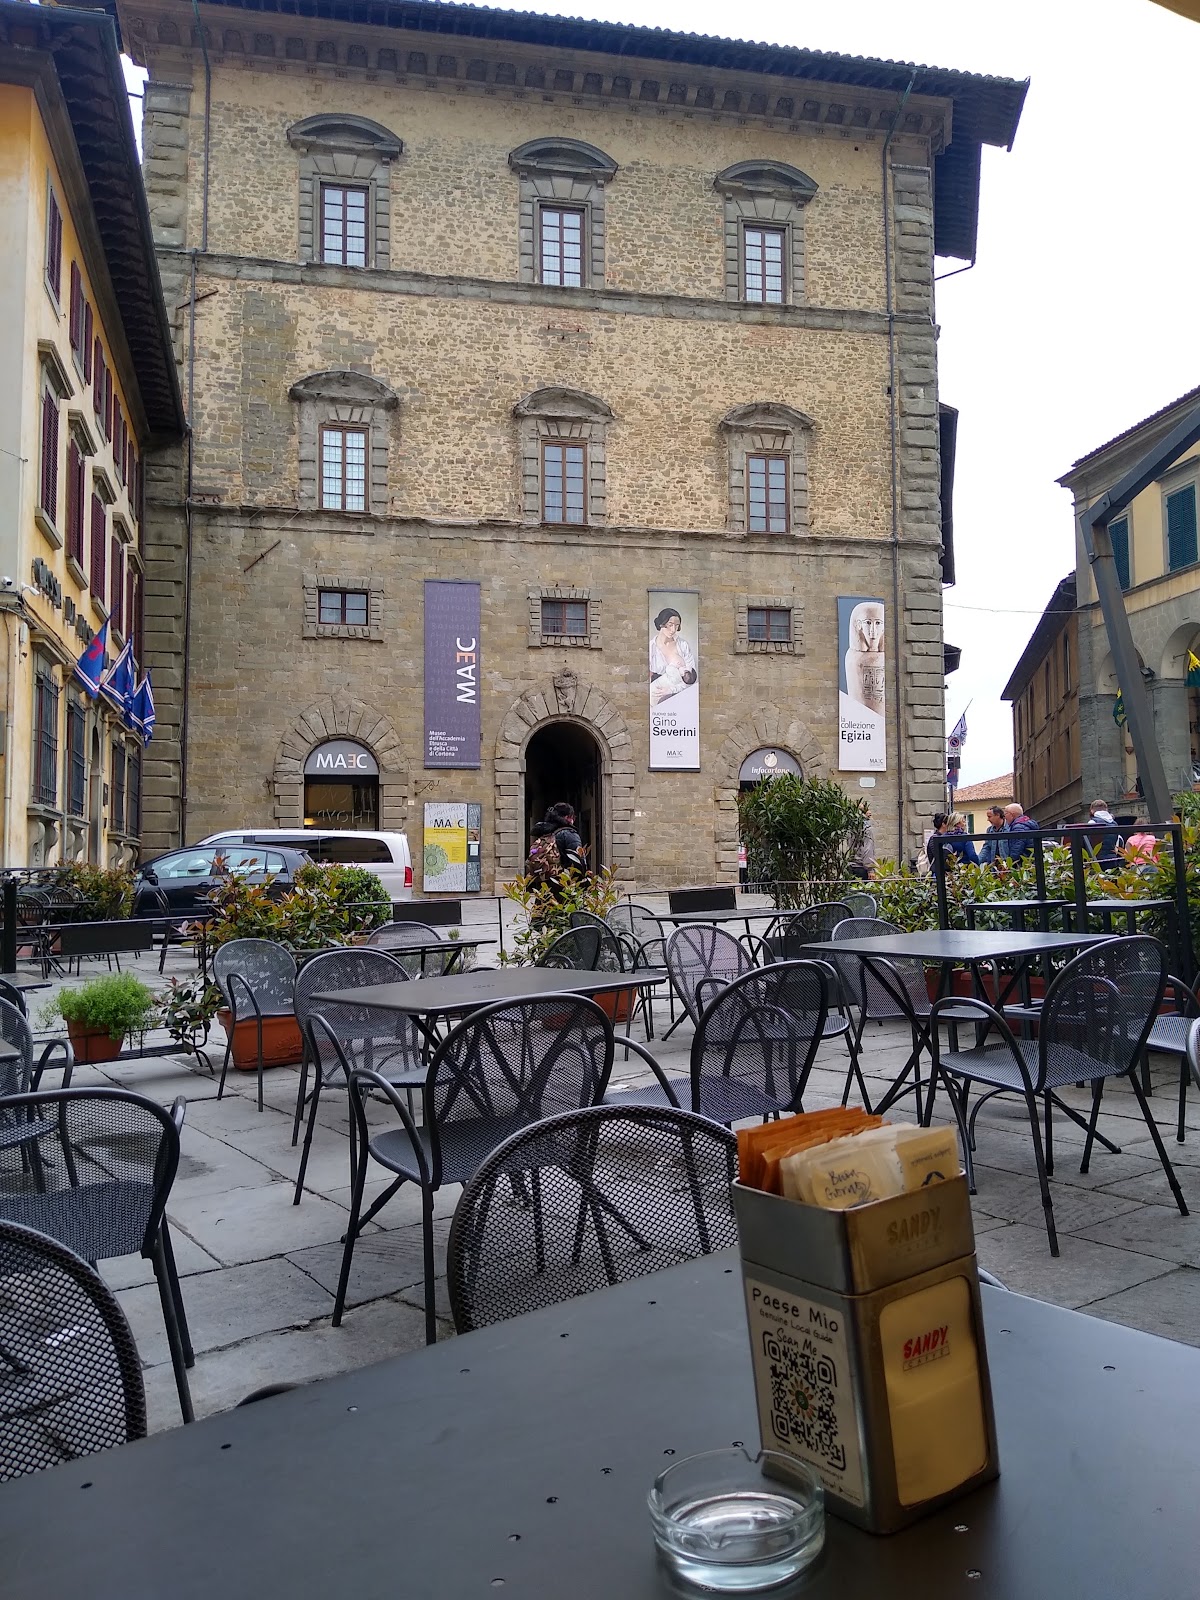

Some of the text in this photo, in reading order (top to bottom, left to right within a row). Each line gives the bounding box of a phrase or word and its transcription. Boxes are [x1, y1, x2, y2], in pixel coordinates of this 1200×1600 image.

[652, 716, 677, 726] Gino
[652, 726, 697, 737] Severini
[841, 721, 875, 730] collezione
[841, 730, 871, 743] Egizia
[886, 1205, 940, 1245] SANDY
[752, 1287, 839, 1333] Paese Mio
[759, 1308, 833, 1344] Genuine Local Guide
[776, 1327, 817, 1356] Scan Me
[903, 1324, 949, 1359] SANDY
